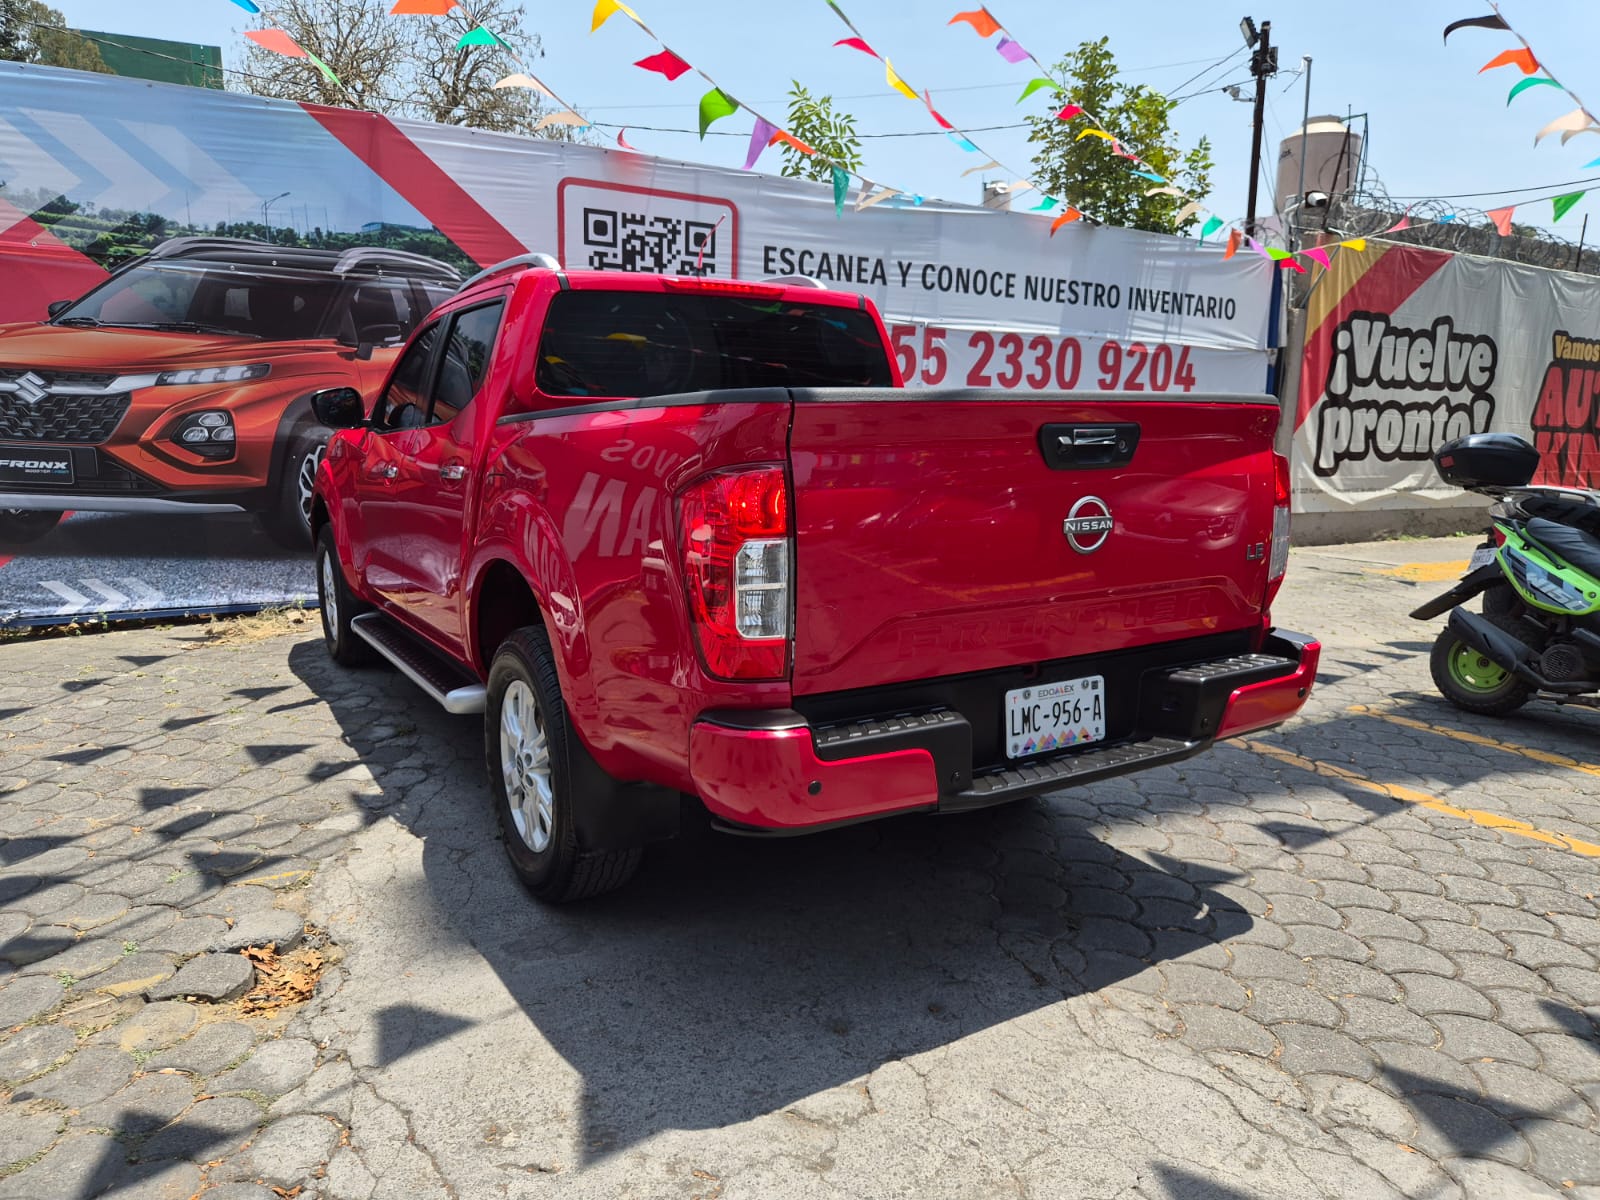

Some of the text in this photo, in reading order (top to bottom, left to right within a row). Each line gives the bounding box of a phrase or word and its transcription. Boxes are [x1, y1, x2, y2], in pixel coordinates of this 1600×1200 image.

[762, 245, 1237, 321] ESCANEA Y CONOCE NUESTRO INVENTARIO
[889, 325, 1197, 393] 55 2330 9204
[1327, 317, 1494, 397] ¡Vuelve
[1553, 333, 1600, 363] Vamos
[0, 460, 68, 469] FRONX
[1065, 519, 1113, 532] NISSAN
[1246, 542, 1265, 560] LE
[897, 593, 1210, 656] FRONTIER
[1011, 693, 1102, 737] LMC-956-A
